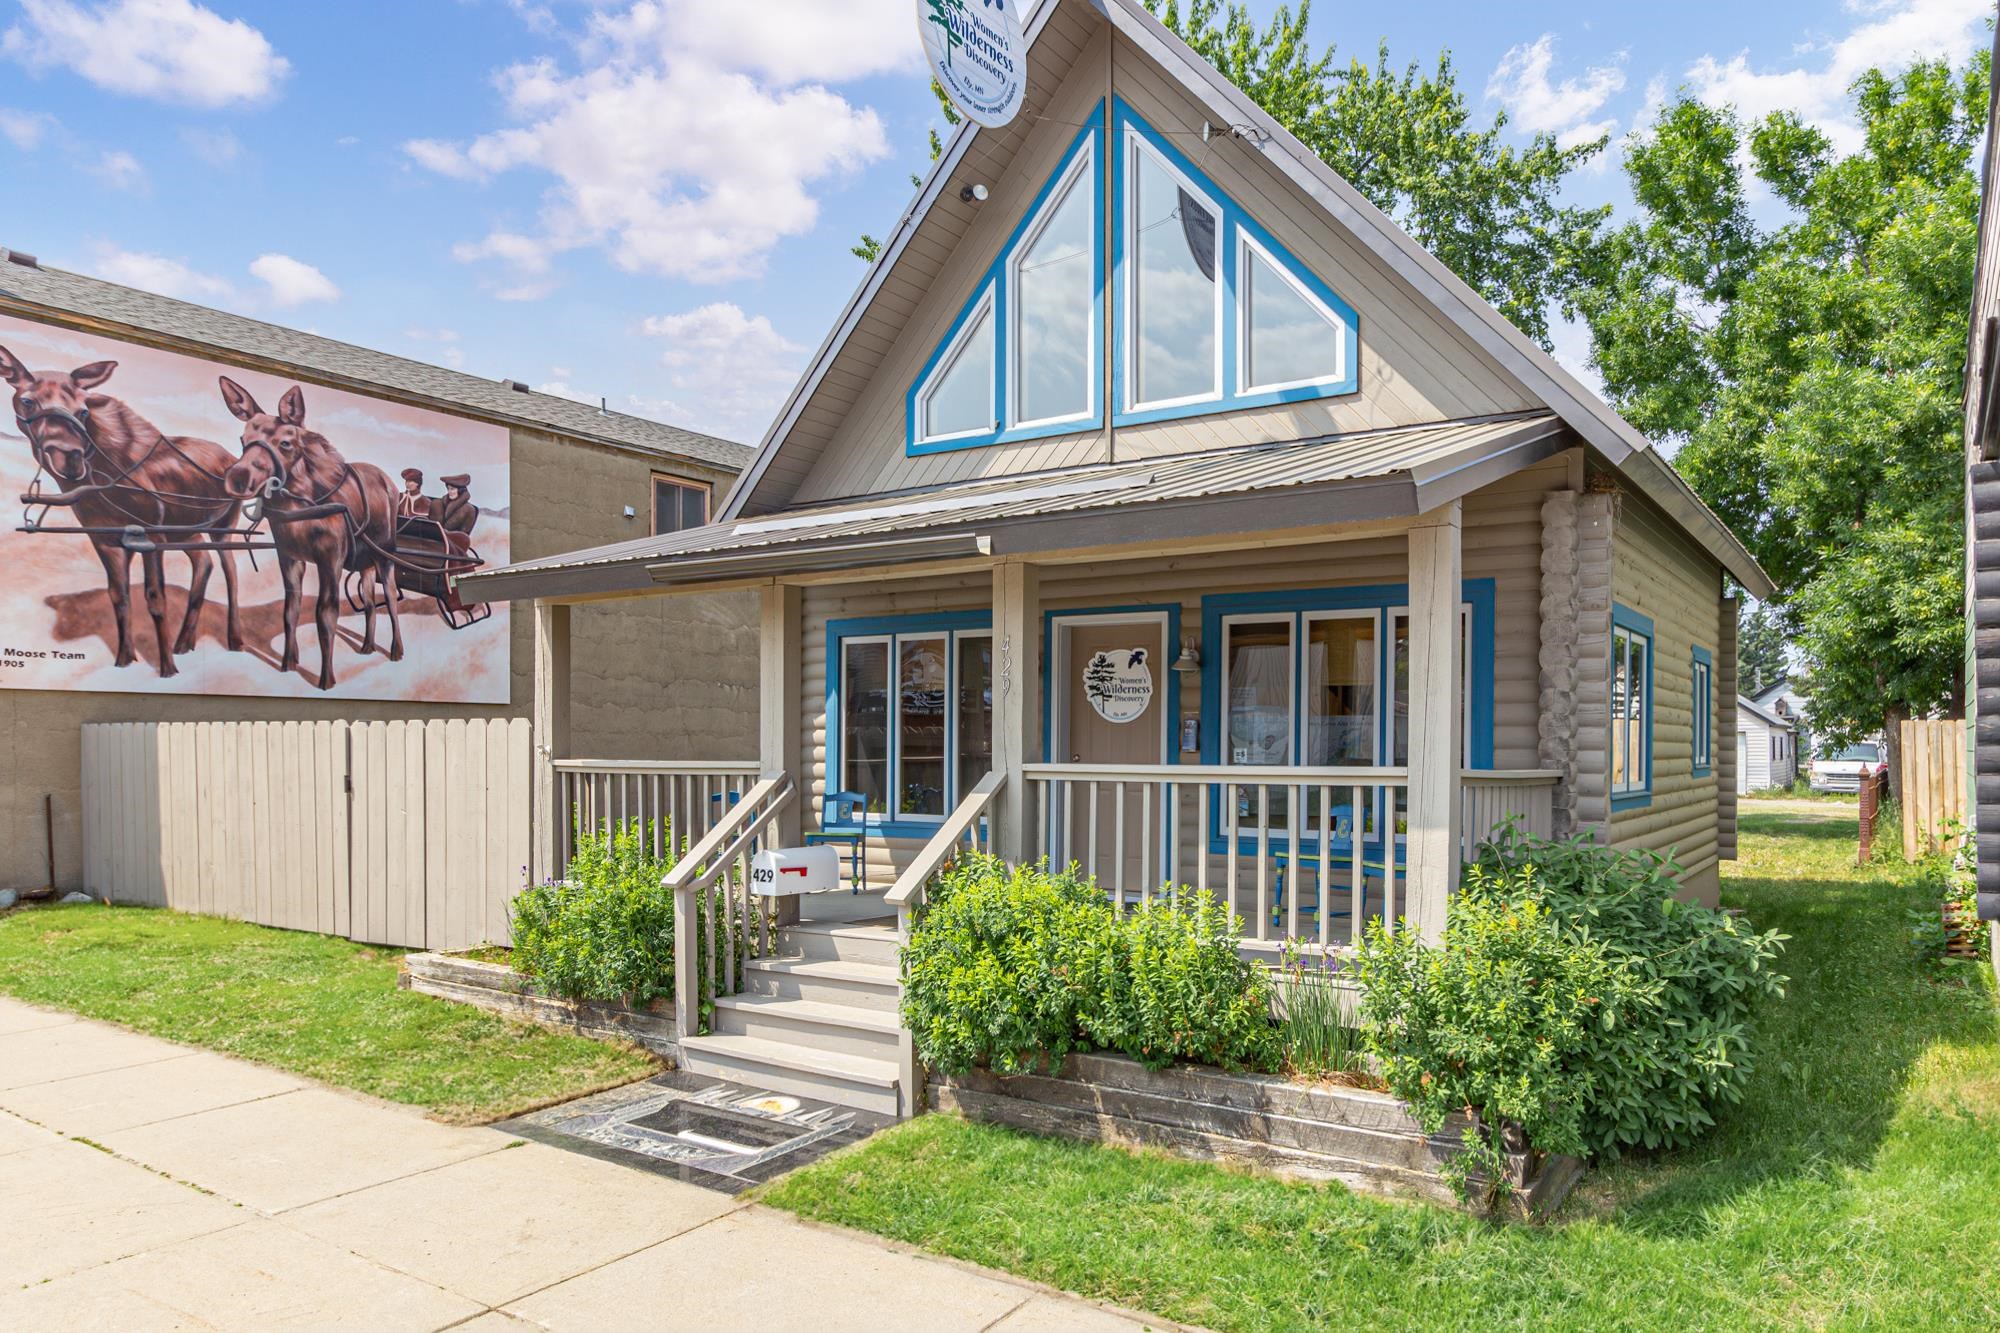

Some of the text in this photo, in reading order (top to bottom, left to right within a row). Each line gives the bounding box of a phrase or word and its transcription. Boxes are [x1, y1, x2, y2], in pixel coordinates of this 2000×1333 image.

[970, 11, 1009, 51] Women's
[945, 7, 1014, 73] Wilderness
[963, 42, 1007, 85] Discovery
[4, 647, 86, 660] Moose Team
[1119, 676, 1147, 684] Women's
[1102, 683, 1151, 694] Wilderness
[1114, 694, 1144, 703] Discovery
[753, 868, 774, 883] 429
